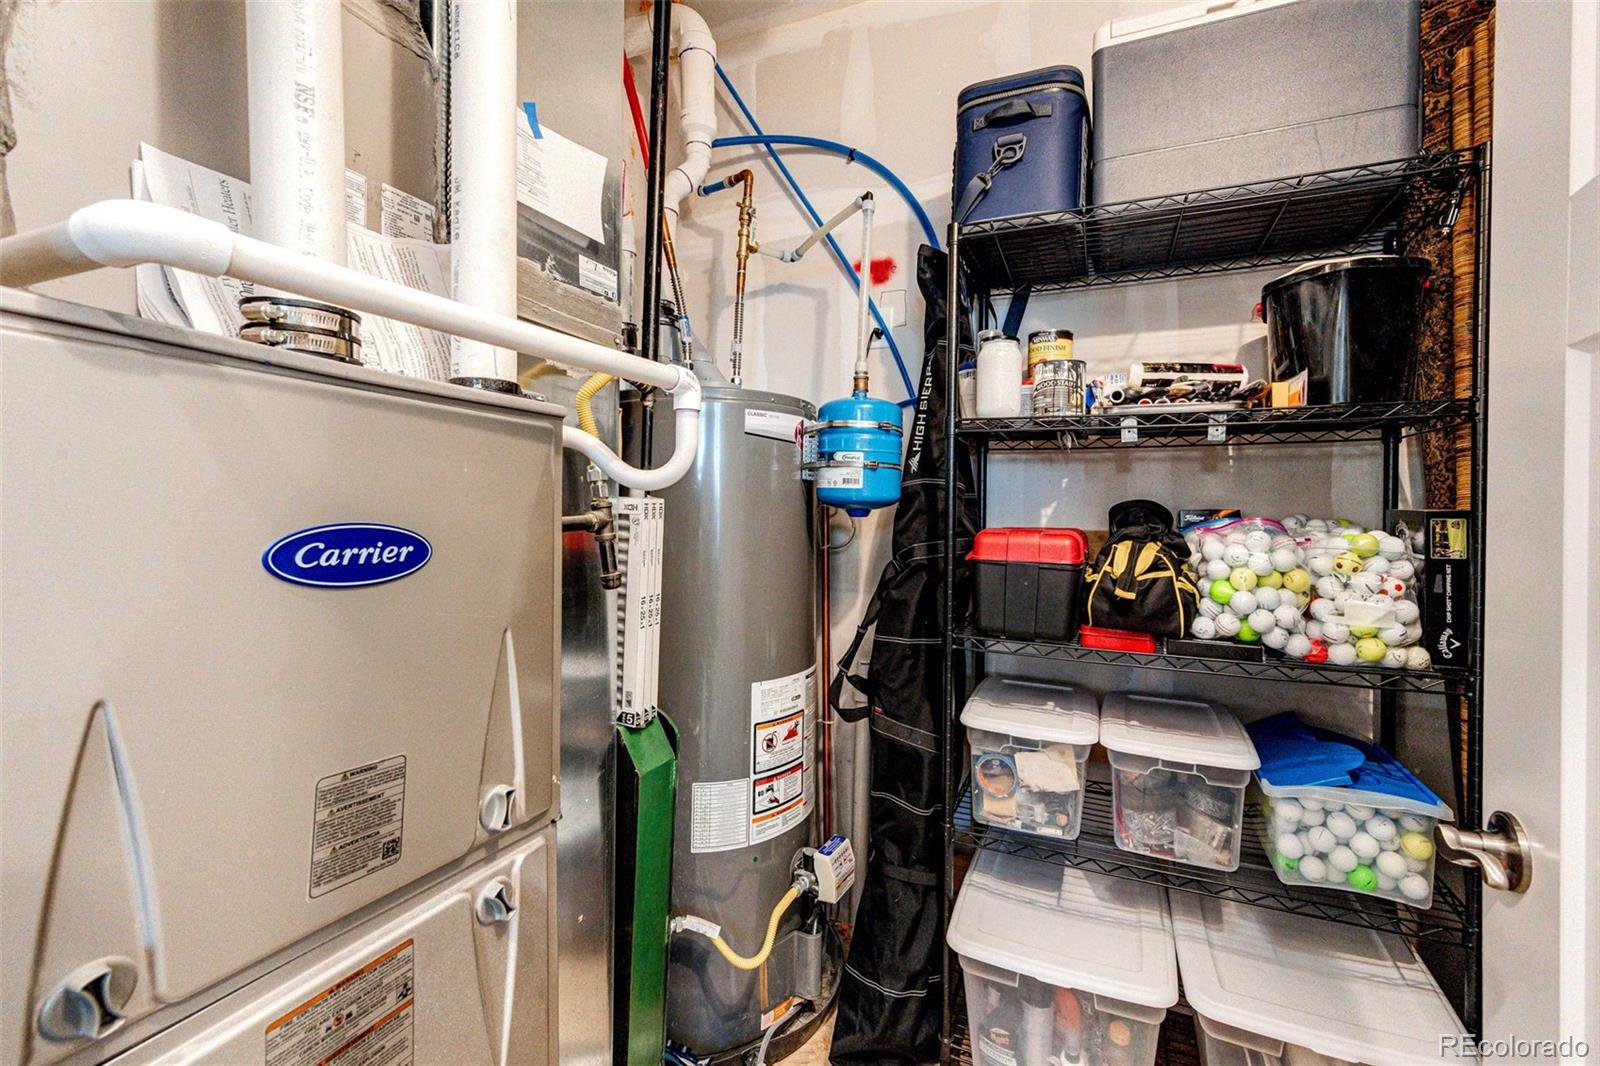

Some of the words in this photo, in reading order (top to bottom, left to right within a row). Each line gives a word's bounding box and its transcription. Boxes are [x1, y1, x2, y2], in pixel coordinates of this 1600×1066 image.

[220, 180, 236, 214] Heaters
[1029, 346, 1042, 354] OOD
[1036, 380, 1056, 390] WOOD
[1057, 380, 1076, 388] STAIN
[912, 414, 926, 452] HIGH
[294, 542, 414, 568] Carrier
[1437, 628, 1454, 660] Callaway
[626, 714, 633, 724] 5
